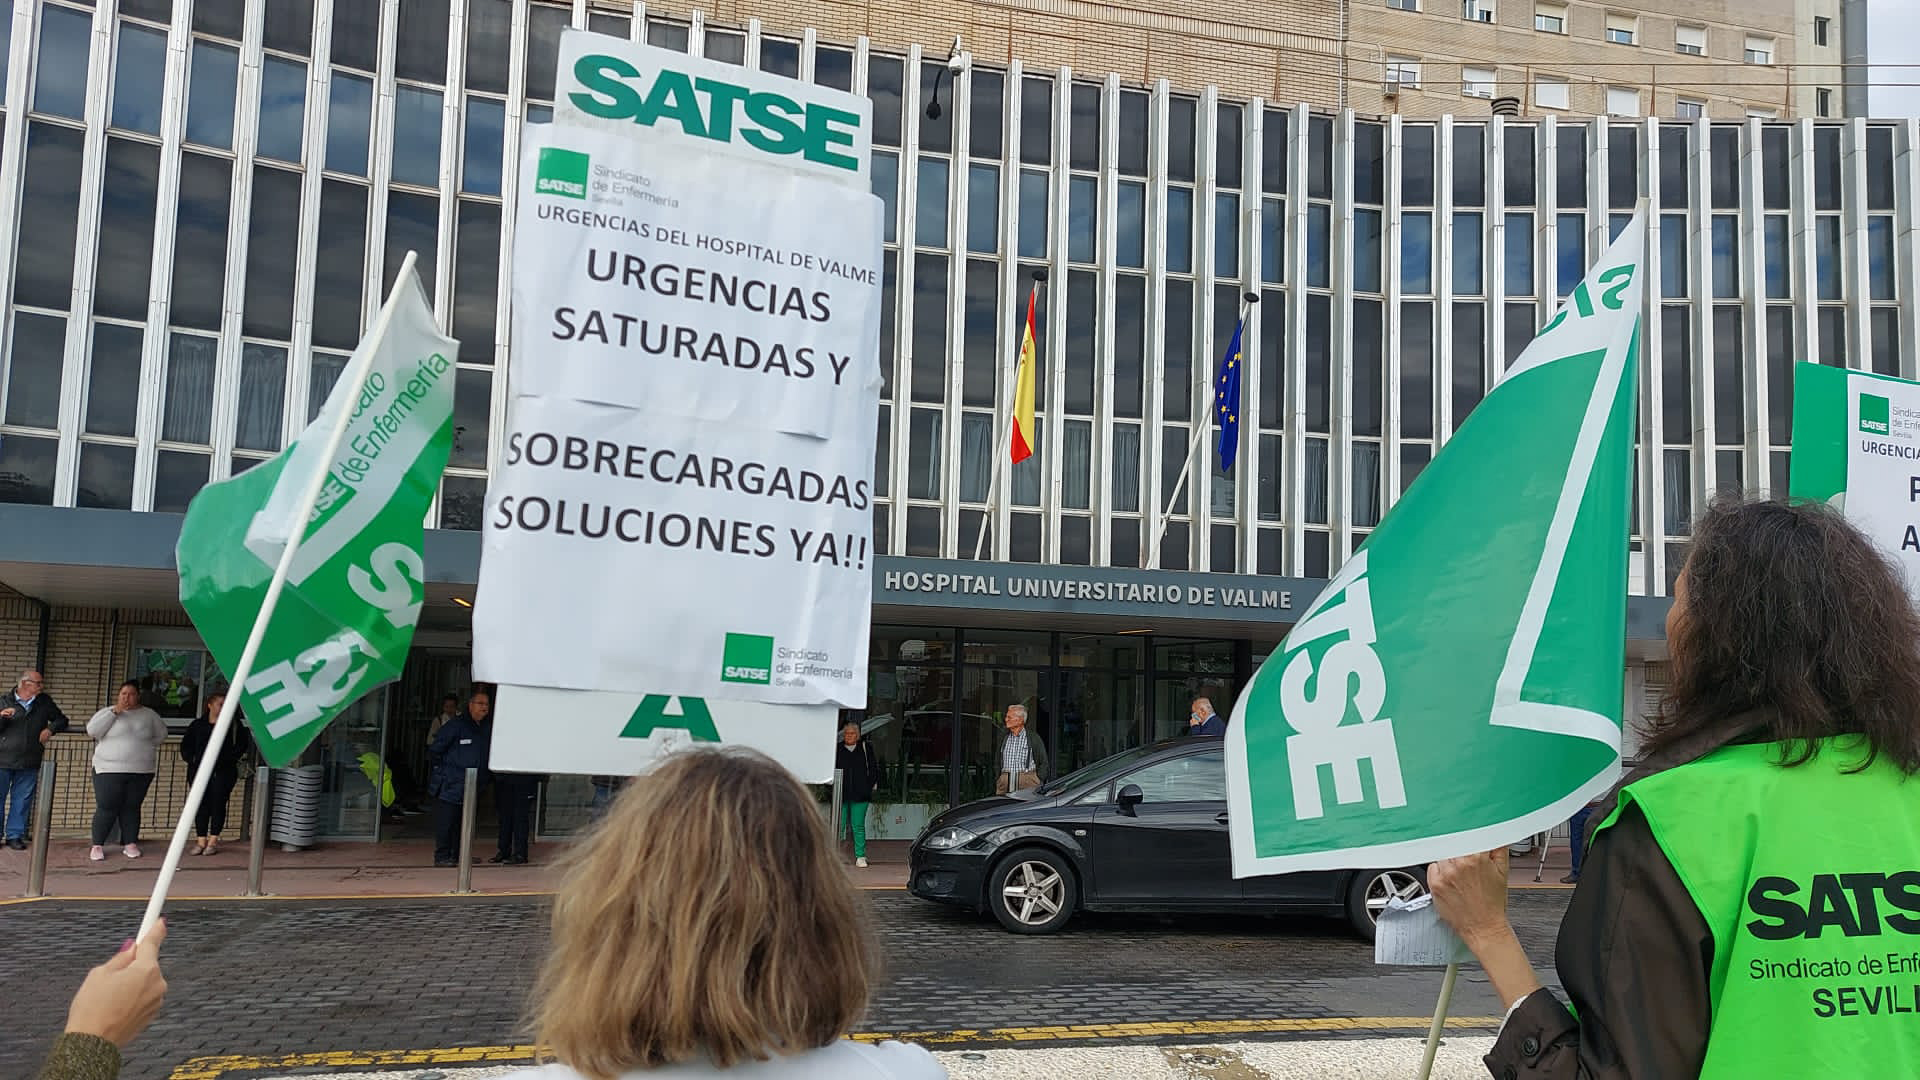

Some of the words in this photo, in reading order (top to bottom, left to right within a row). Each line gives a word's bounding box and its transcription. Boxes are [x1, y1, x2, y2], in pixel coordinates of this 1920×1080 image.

[568, 53, 860, 171] SATSE
[538, 178, 584, 195] SATSE
[592, 181, 608, 192] de
[593, 164, 651, 186] Sindicato
[537, 204, 651, 238] URGENCIAS
[656, 227, 690, 247] DEL
[696, 234, 784, 265] HOSPITAL
[790, 252, 814, 270] DE
[818, 257, 877, 286] VALME
[587, 248, 832, 323] URGENCIAS
[552, 306, 816, 379] SATURADAS
[828, 352, 851, 386] Y
[351, 352, 450, 460] Enfermería
[338, 457, 370, 483] de
[506, 432, 869, 512] SOBRECARGADAS
[493, 495, 776, 557] SOLUCIONES
[789, 528, 867, 571] YA!!
[884, 571, 1000, 596] HOSPITAL
[1007, 577, 1182, 604] UNIVERSITARIO
[1187, 586, 1216, 606] DE
[1220, 588, 1292, 609] VALME
[775, 663, 791, 674] de
[777, 646, 829, 662] Sindicato
[724, 666, 769, 681] SATSE
[1750, 957, 1851, 980] Sindicato
[1857, 954, 1883, 975] de
[1887, 952, 1920, 974] Enf
